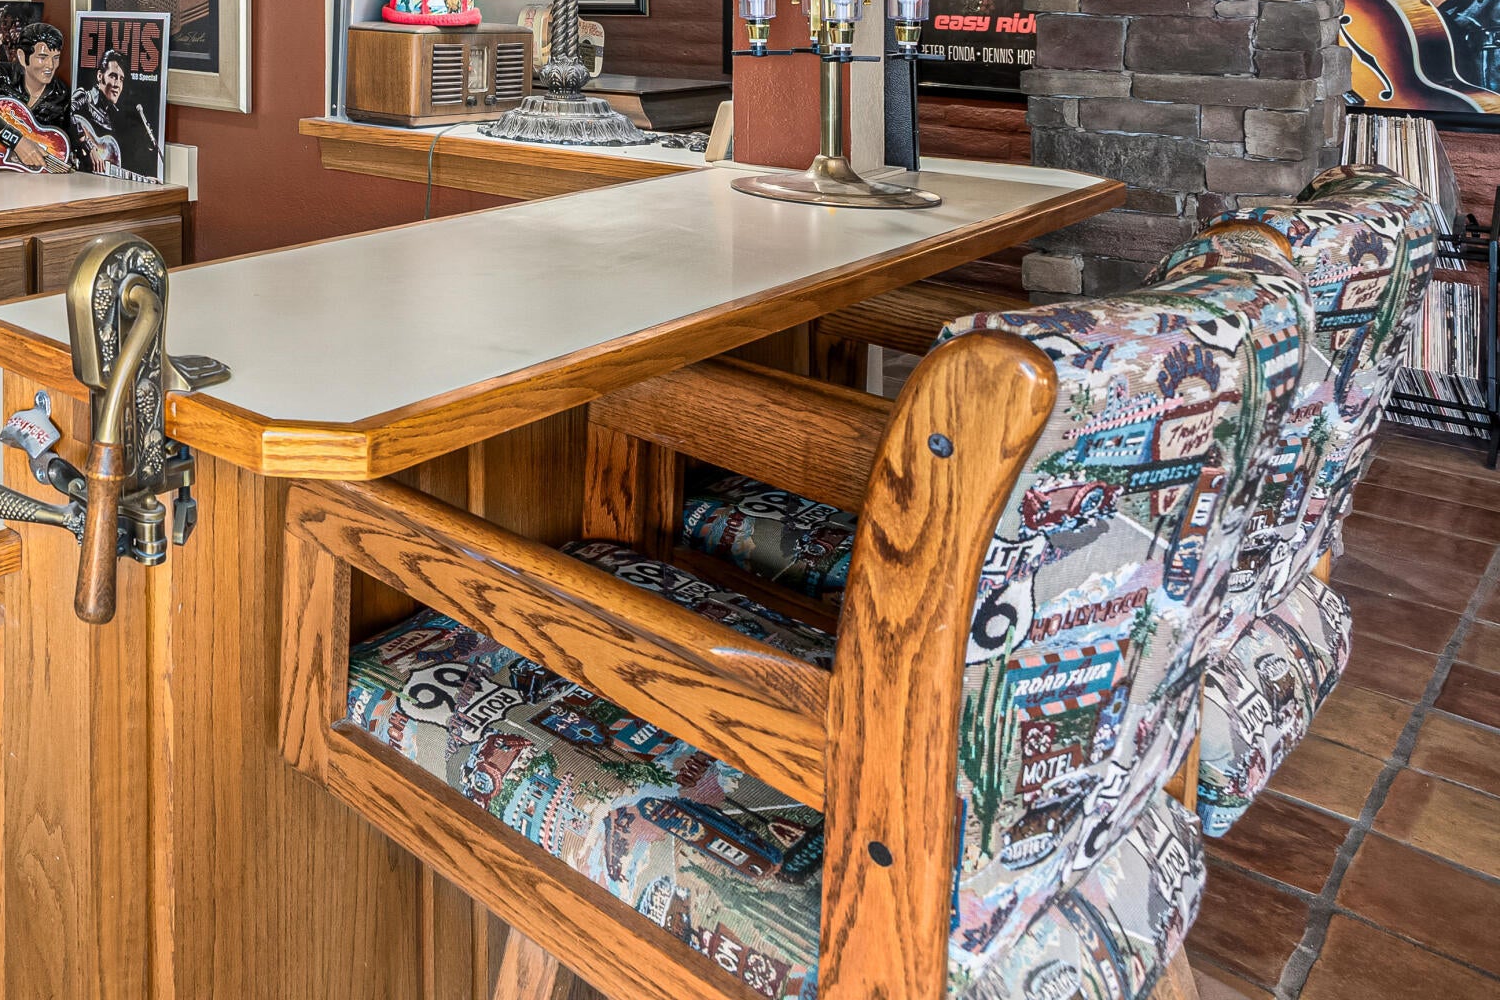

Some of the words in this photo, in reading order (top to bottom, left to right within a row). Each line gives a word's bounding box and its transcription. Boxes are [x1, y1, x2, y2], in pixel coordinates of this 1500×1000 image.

[934, 15, 990, 32] easy
[80, 20, 160, 72] ELVIS
[948, 45, 975, 61] FONDA
[982, 48, 1014, 64] DENNIS
[139, 73, 158, 81] Special
[1030, 587, 1148, 642] HOLLYWOOD
[1014, 672, 1062, 697] ROAD
[468, 690, 518, 736] ROUTE
[1022, 752, 1071, 787] MOTEL
